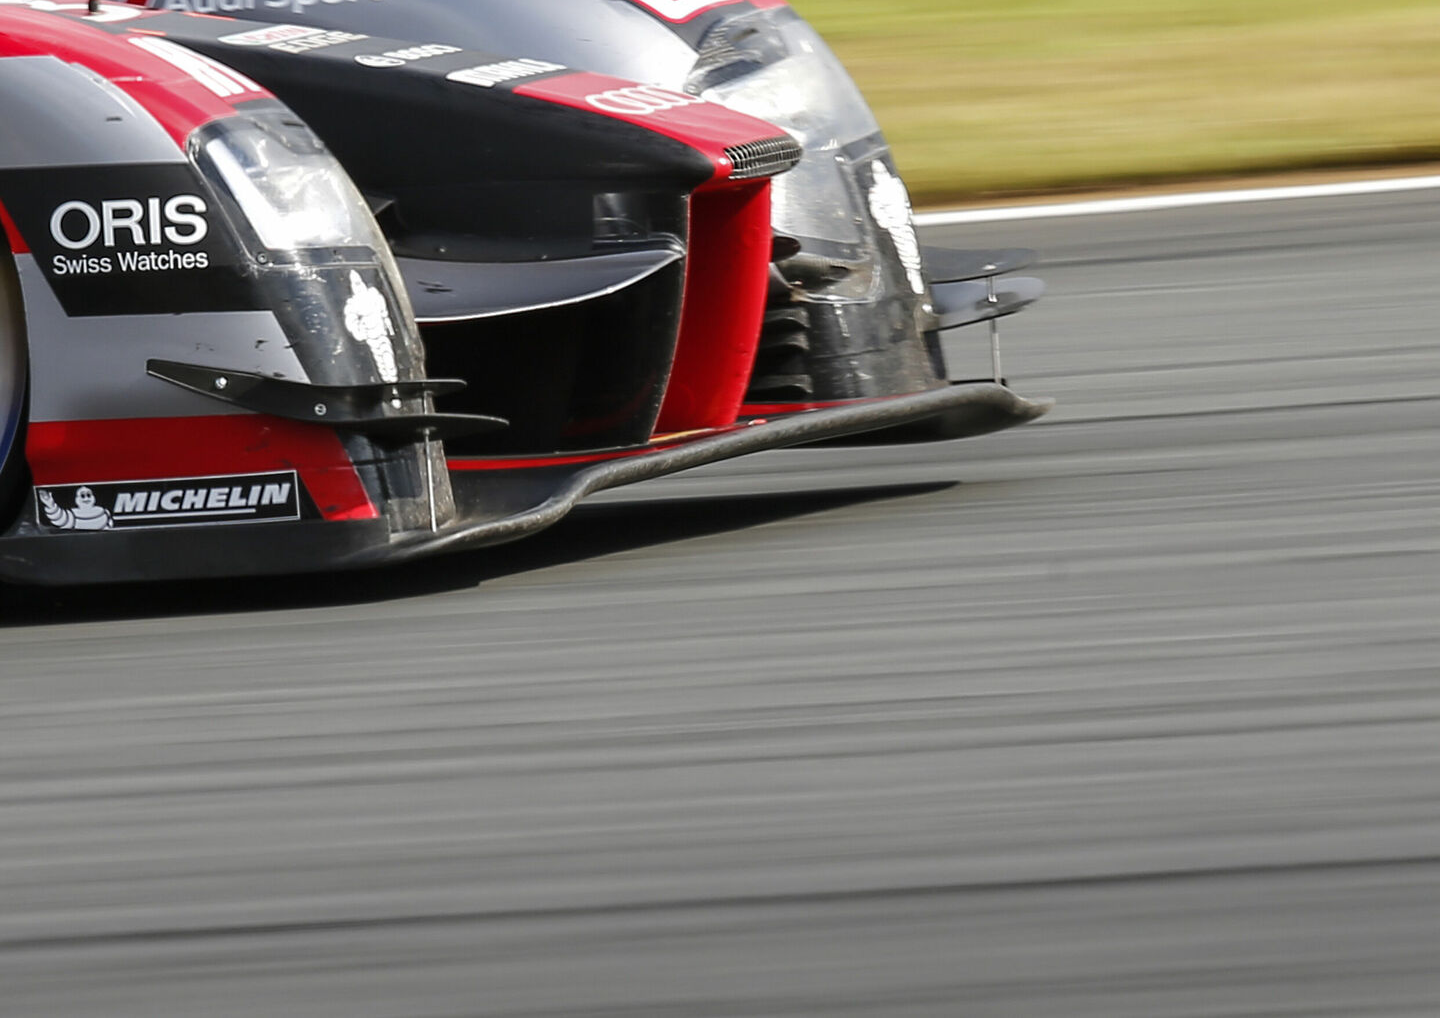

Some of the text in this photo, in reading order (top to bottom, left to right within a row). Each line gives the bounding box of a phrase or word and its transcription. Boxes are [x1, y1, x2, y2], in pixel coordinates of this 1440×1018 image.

[50, 195, 209, 250] ORIS
[53, 250, 209, 275] Swiss Watches
[113, 482, 291, 513] MICHELIN
